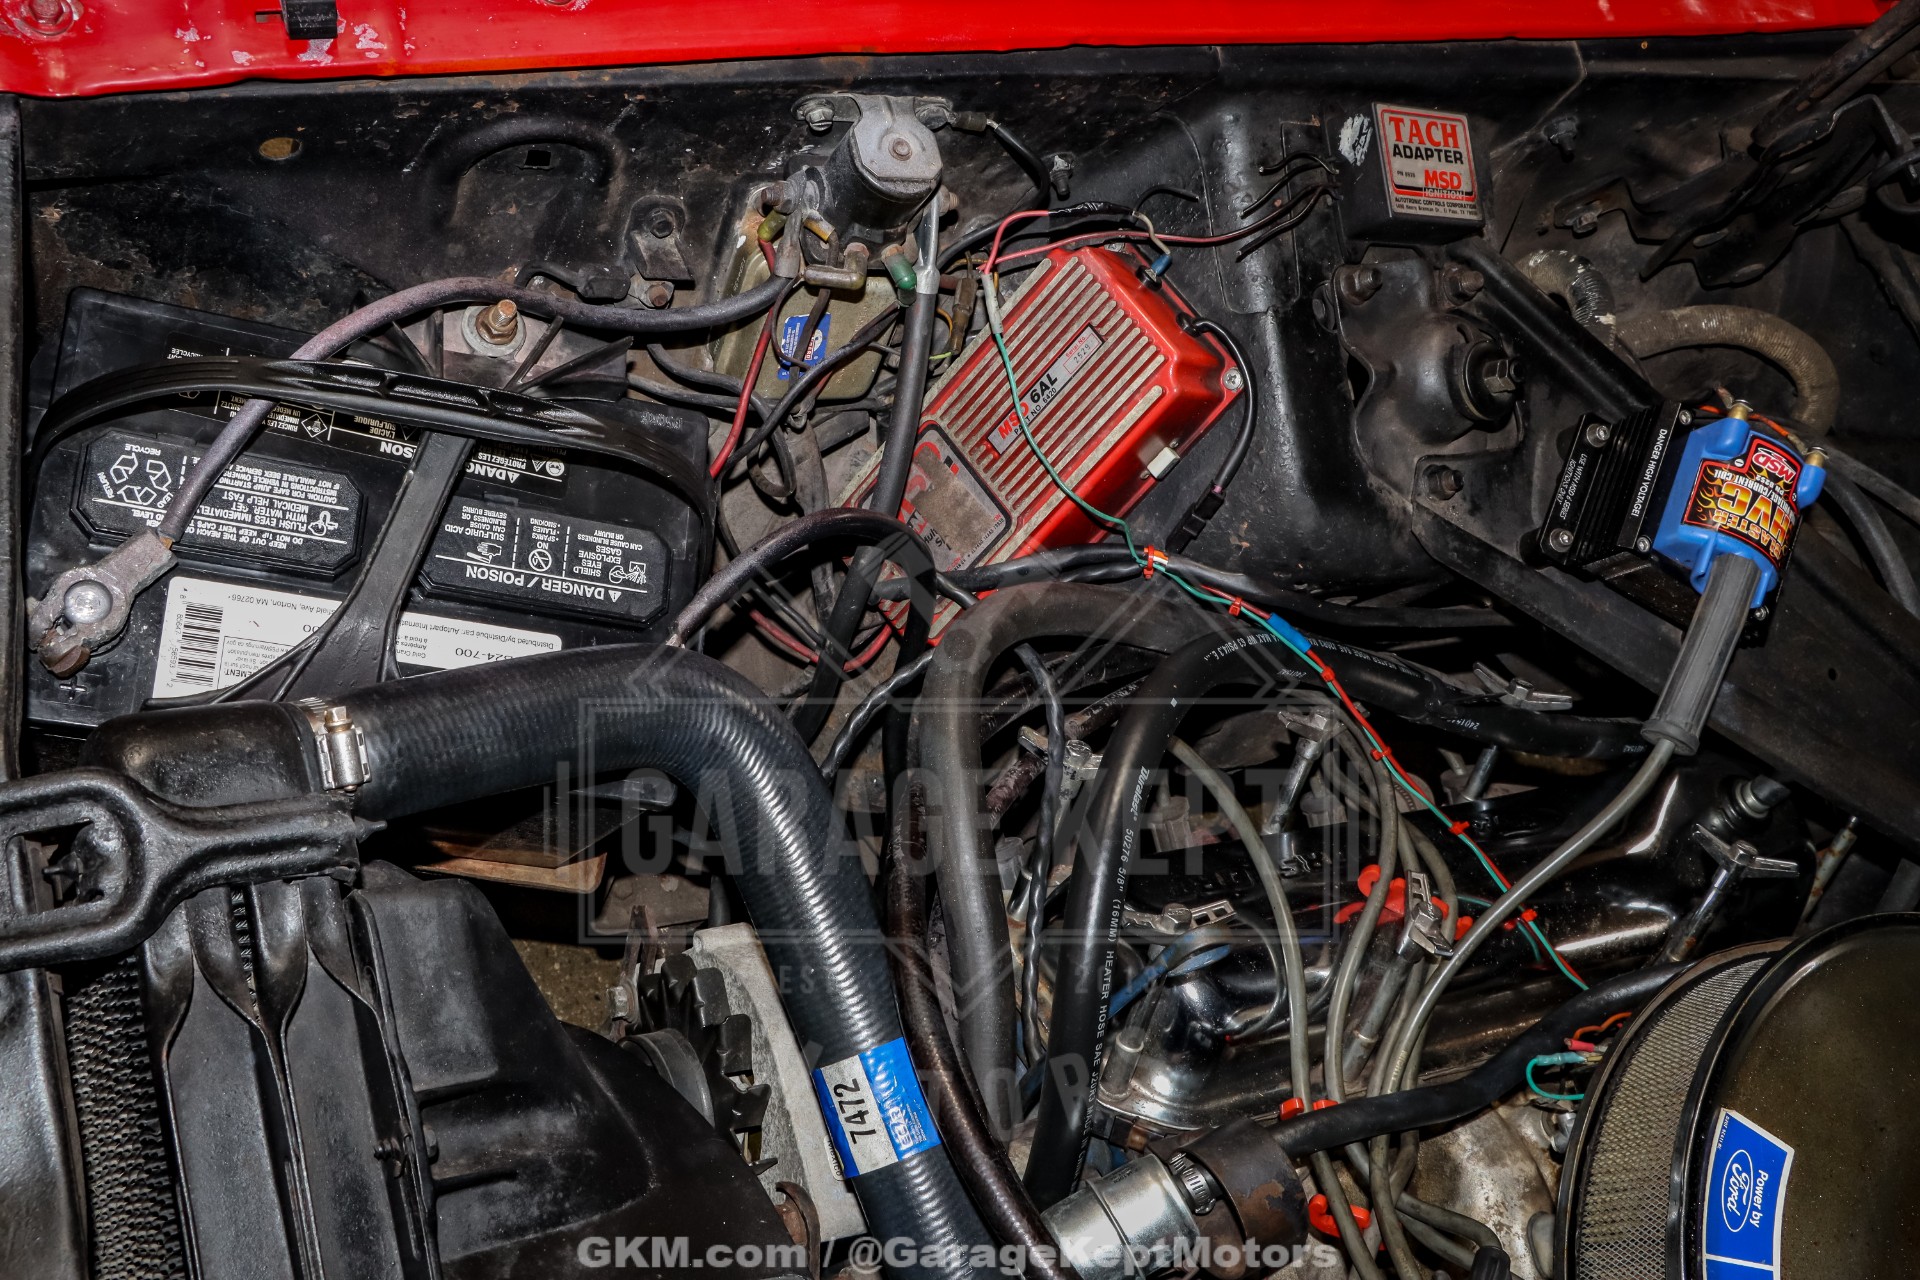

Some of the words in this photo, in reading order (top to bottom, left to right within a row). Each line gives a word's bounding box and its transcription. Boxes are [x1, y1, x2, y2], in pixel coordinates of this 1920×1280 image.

[1389, 116, 1460, 148] TACH
[1393, 144, 1464, 164] ADAPTER
[1424, 169, 1462, 190] MSD
[1425, 188, 1464, 199] IGNITION
[1026, 370, 1059, 405] 6AL
[1012, 414, 1032, 435] PAT
[1041, 386, 1057, 403] 6420
[124, 442, 161, 456] RECYCLE
[1650, 428, 1667, 460] DANGER
[1643, 459, 1656, 481] HIGH
[1714, 468, 1732, 480] COIL
[1754, 451, 1796, 483] MSD
[221, 490, 244, 502] FAST
[246, 494, 269, 506] HELP
[1630, 480, 1649, 517] VOLTAGE!
[271, 498, 309, 513] MEDICAL
[1722, 481, 1786, 540] HVC
[253, 514, 276, 526] EYES
[285, 510, 308, 522] WITH
[278, 518, 306, 531] FLUSH
[443, 523, 463, 533] ACID
[222, 532, 237, 540] THE
[238, 534, 249, 542] OF
[251, 536, 266, 545] OUT
[275, 533, 290, 542] NOT
[291, 536, 302, 544] DO
[464, 527, 504, 540] SULFURIC
[268, 539, 286, 549] KEEP
[536, 540, 548, 549] NO
[594, 544, 622, 555] GASES
[577, 549, 621, 563] EXPLOSIVE
[580, 558, 602, 568] EYES
[464, 564, 525, 586] POISON
[572, 565, 601, 577] SHIELD
[541, 577, 605, 600] DANGER
[255, 597, 268, 605] MA
[269, 598, 296, 609] Norton,
[298, 602, 313, 612] Ave,
[429, 623, 459, 634] Autopart
[516, 637, 554, 649] Distributed
[1128, 764, 1150, 818] Duralast
[1118, 827, 1134, 863] 50276
[1113, 866, 1126, 892] 5/8"
[1105, 898, 1122, 943] (16MM)
[1098, 949, 1116, 1000] HEATER
[1095, 1003, 1107, 1039] HOSE
[1092, 1042, 1102, 1067] SAE
[832, 1077, 876, 1144] 7472
[1724, 1162, 1752, 1217] Ford
[1752, 1169, 1769, 1209] Power
[1748, 1210, 1763, 1228] by
